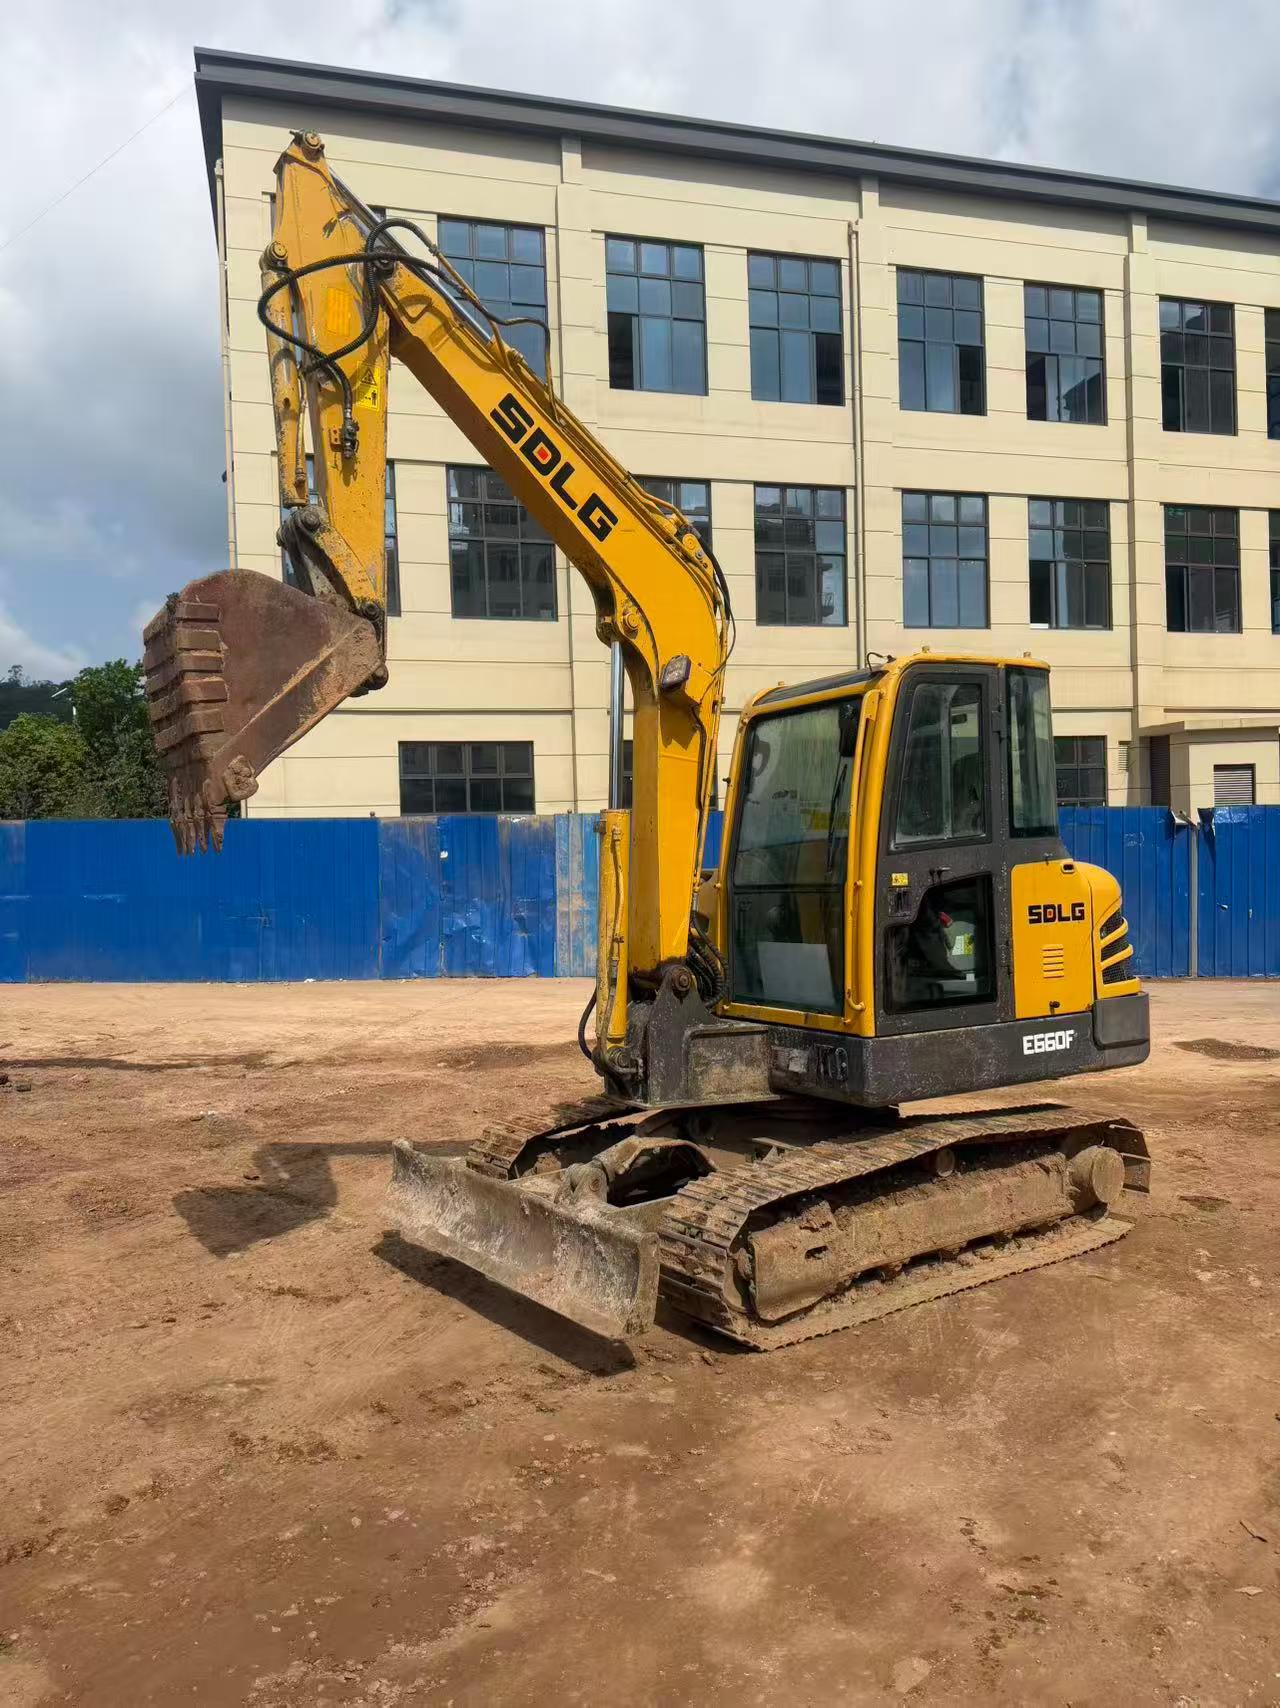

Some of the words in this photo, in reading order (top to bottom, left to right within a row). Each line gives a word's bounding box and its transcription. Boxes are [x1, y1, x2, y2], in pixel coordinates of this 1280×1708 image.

[490, 393, 619, 543] SDLG
[1028, 902, 1085, 925] SDLG
[1022, 1030, 1075, 1055] E660F
